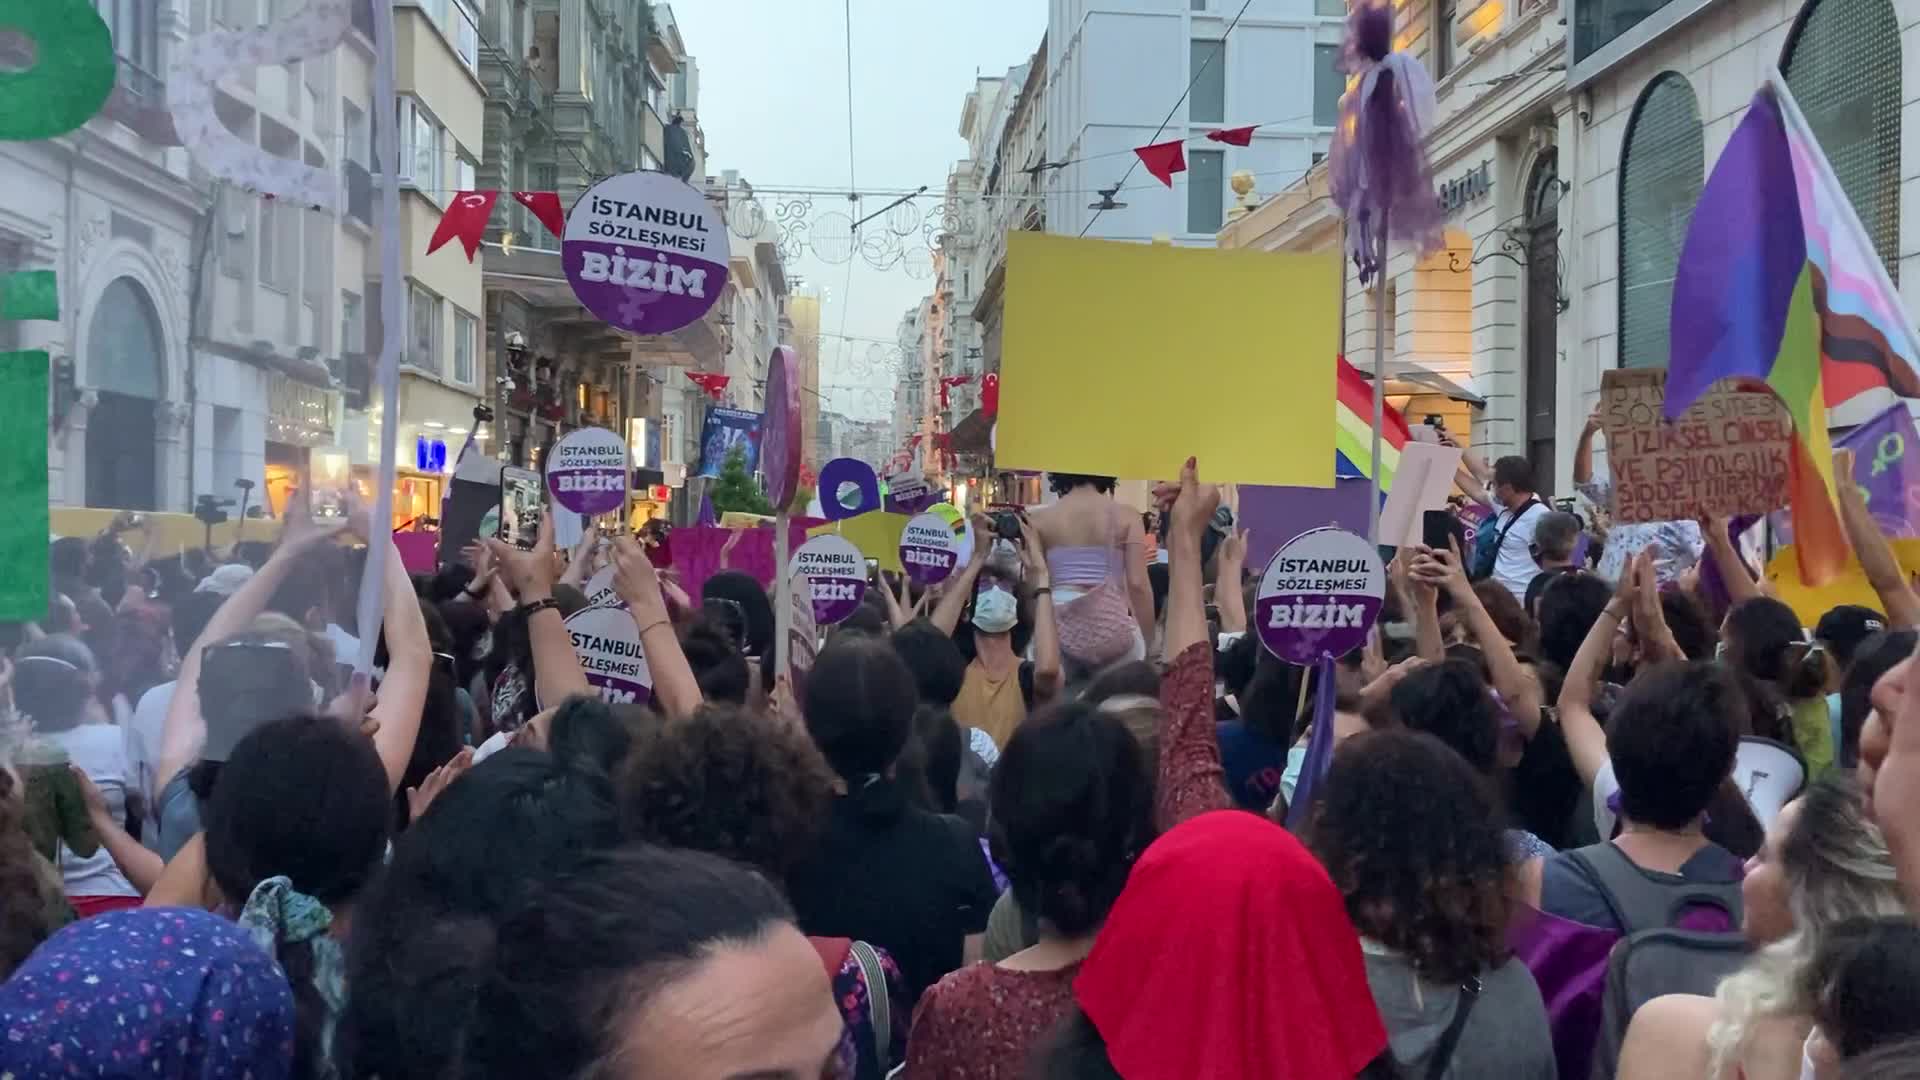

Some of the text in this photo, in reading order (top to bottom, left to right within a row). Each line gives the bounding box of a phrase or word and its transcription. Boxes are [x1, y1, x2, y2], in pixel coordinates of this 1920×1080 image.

[580, 246, 707, 298] BİZİM
[558, 470, 625, 492] BİZİM
[905, 547, 949, 568] BİZİM
[809, 578, 856, 601] İZİM
[1268, 596, 1366, 629] BİZİM
